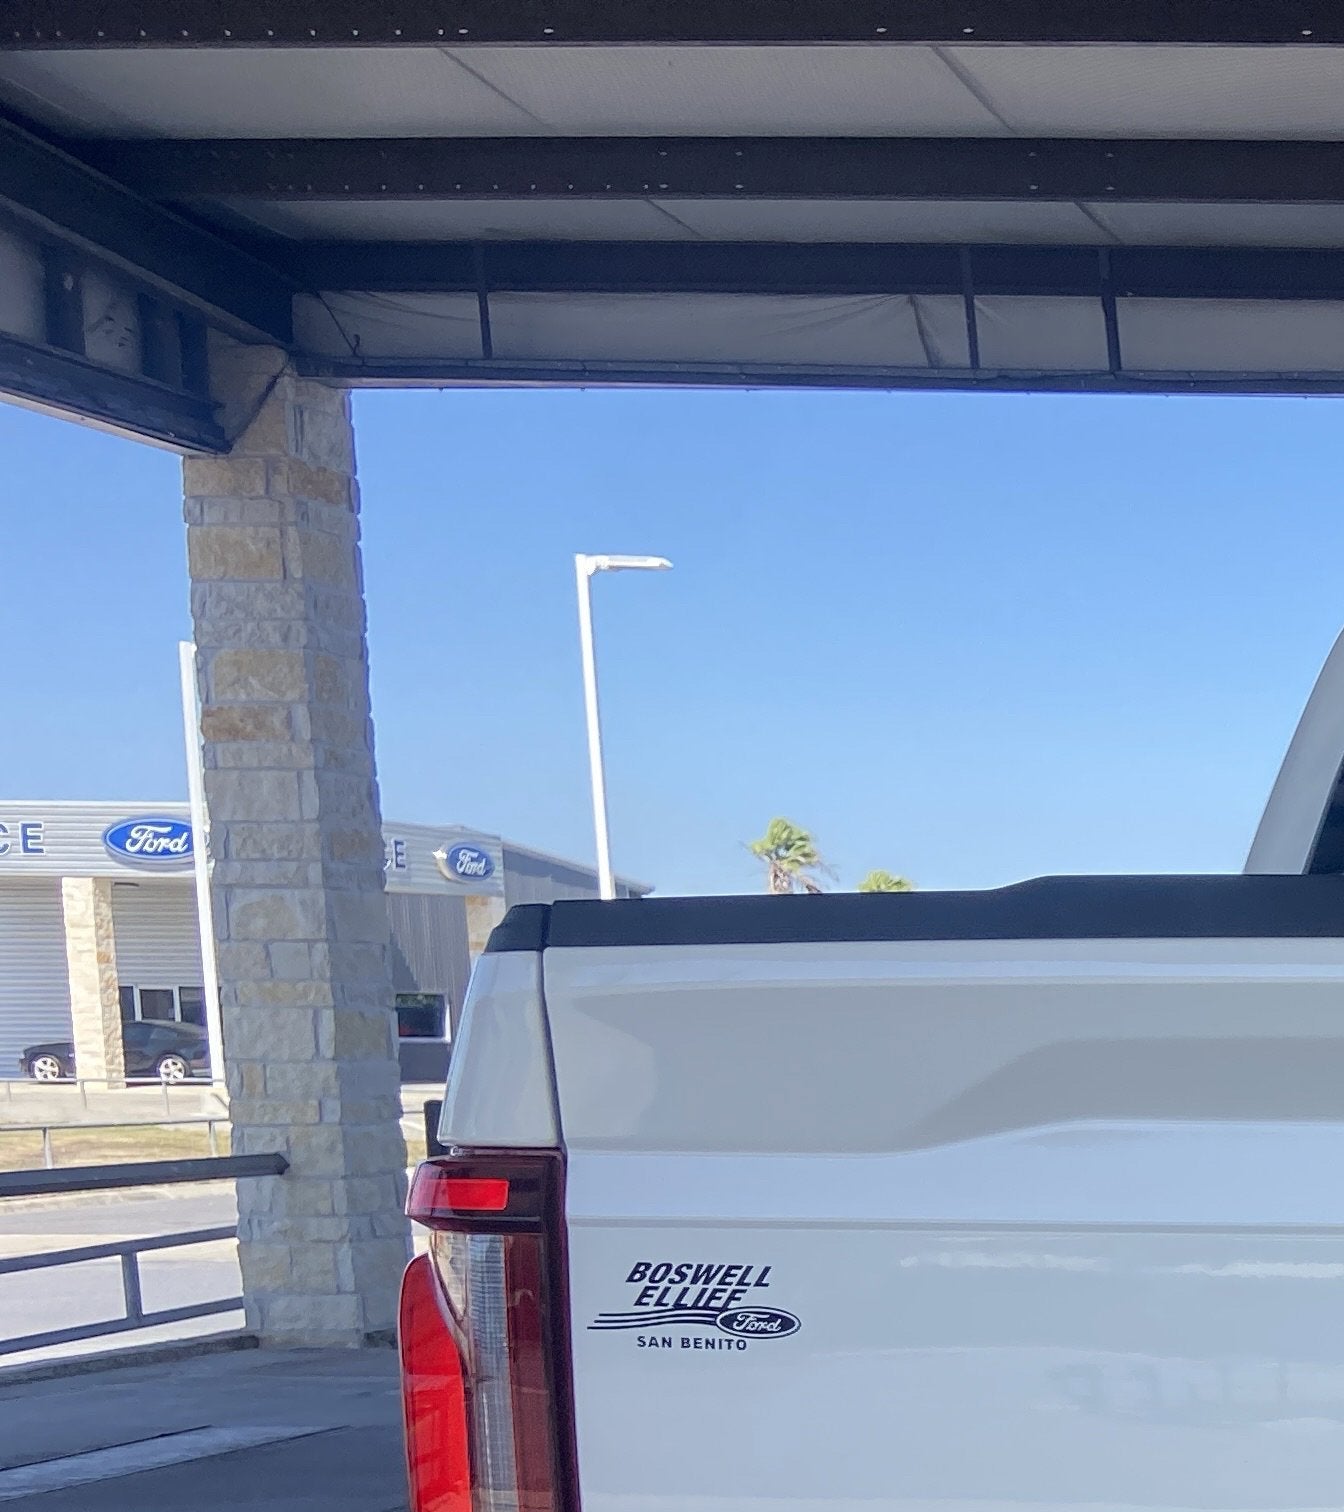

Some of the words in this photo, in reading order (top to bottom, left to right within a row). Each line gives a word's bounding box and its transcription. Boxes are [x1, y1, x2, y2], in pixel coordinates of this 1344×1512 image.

[124, 824, 190, 853] Ford
[456, 848, 487, 876] Ford
[626, 1261, 772, 1288] BOSWELL
[633, 1285, 748, 1310] ELLIFF
[733, 1312, 783, 1333] Ford
[637, 1336, 672, 1348] SAN
[680, 1337, 747, 1351] BENITO
